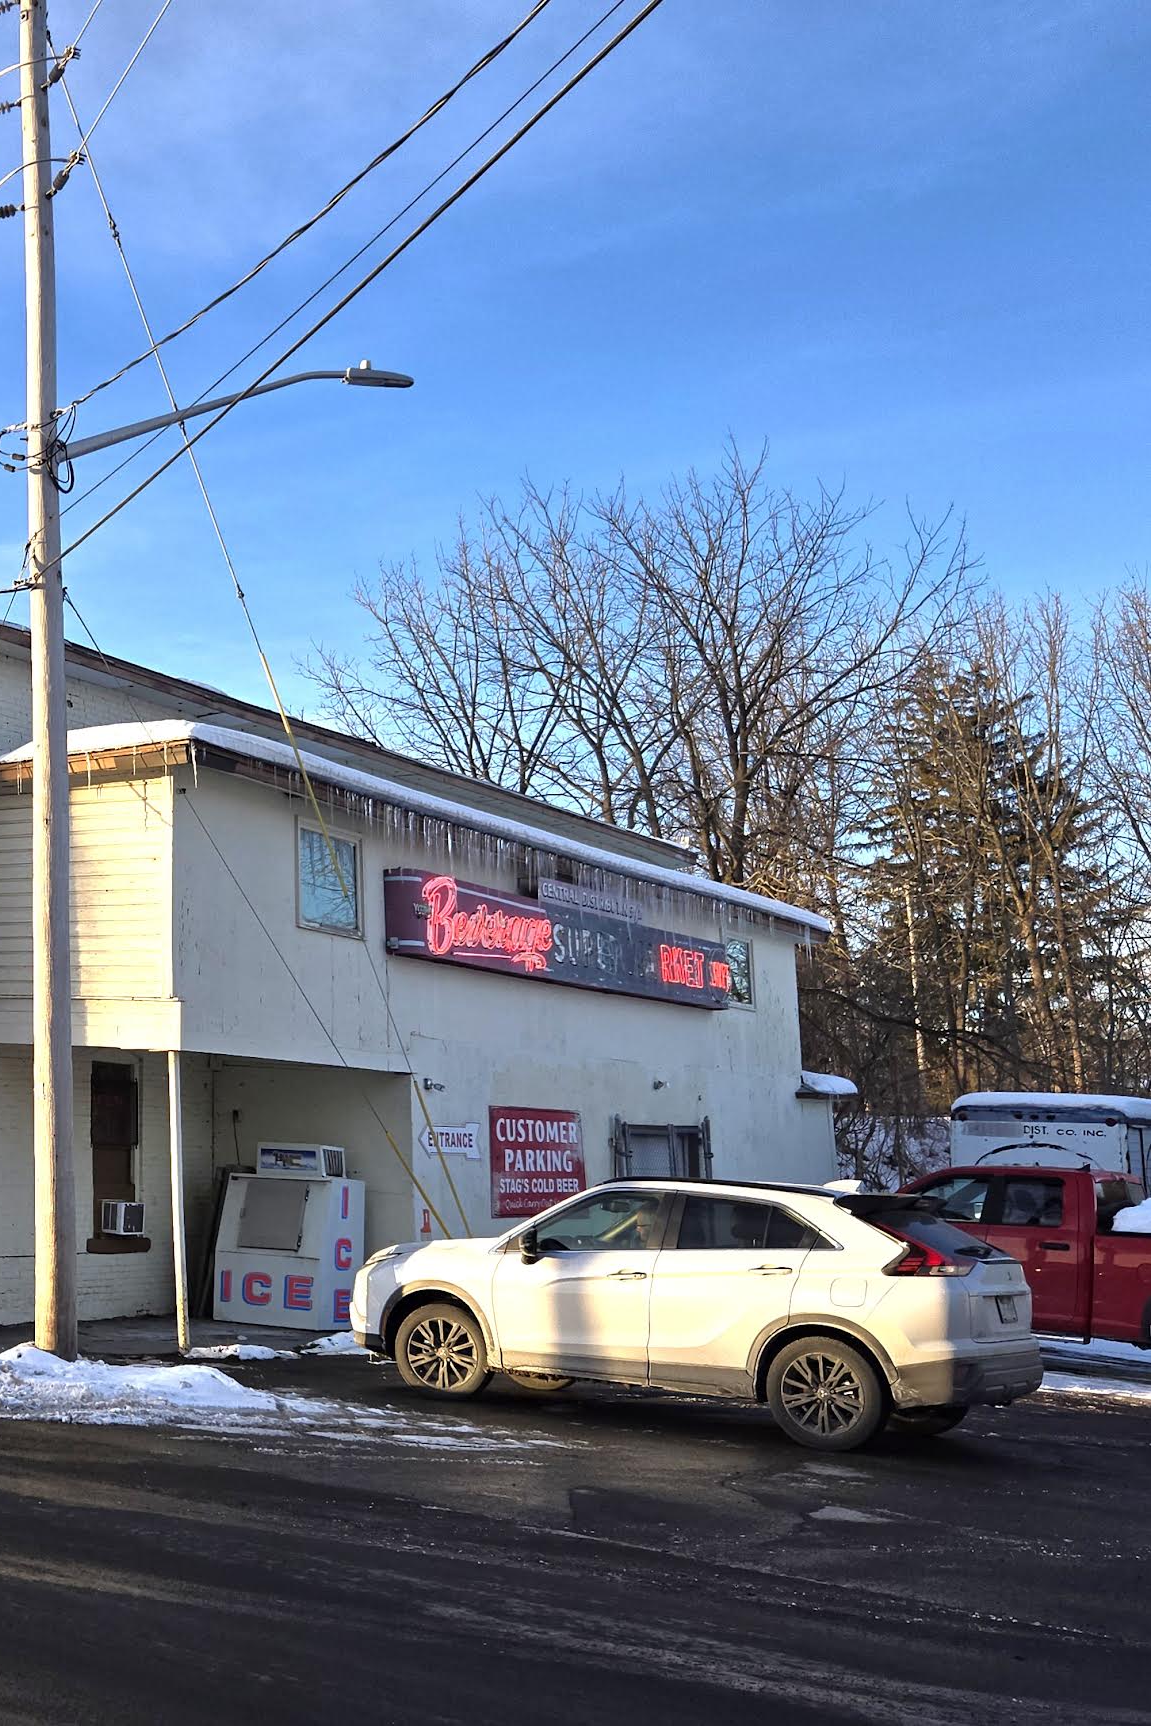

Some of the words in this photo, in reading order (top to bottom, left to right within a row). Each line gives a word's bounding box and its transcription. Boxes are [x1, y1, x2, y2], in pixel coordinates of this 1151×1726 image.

[542, 882, 580, 905] CENTRAL
[422, 876, 553, 972] Beverage
[496, 1117, 579, 1145] CUSTOMER
[1023, 1125, 1049, 1135] DIST.
[505, 1149, 573, 1173] PARKING
[500, 1177, 529, 1194] STAG'S
[531, 1178, 555, 1193] COLD
[557, 1178, 580, 1193] BEER
[505, 1197, 523, 1211] Quick
[220, 1269, 315, 1311] ICE
